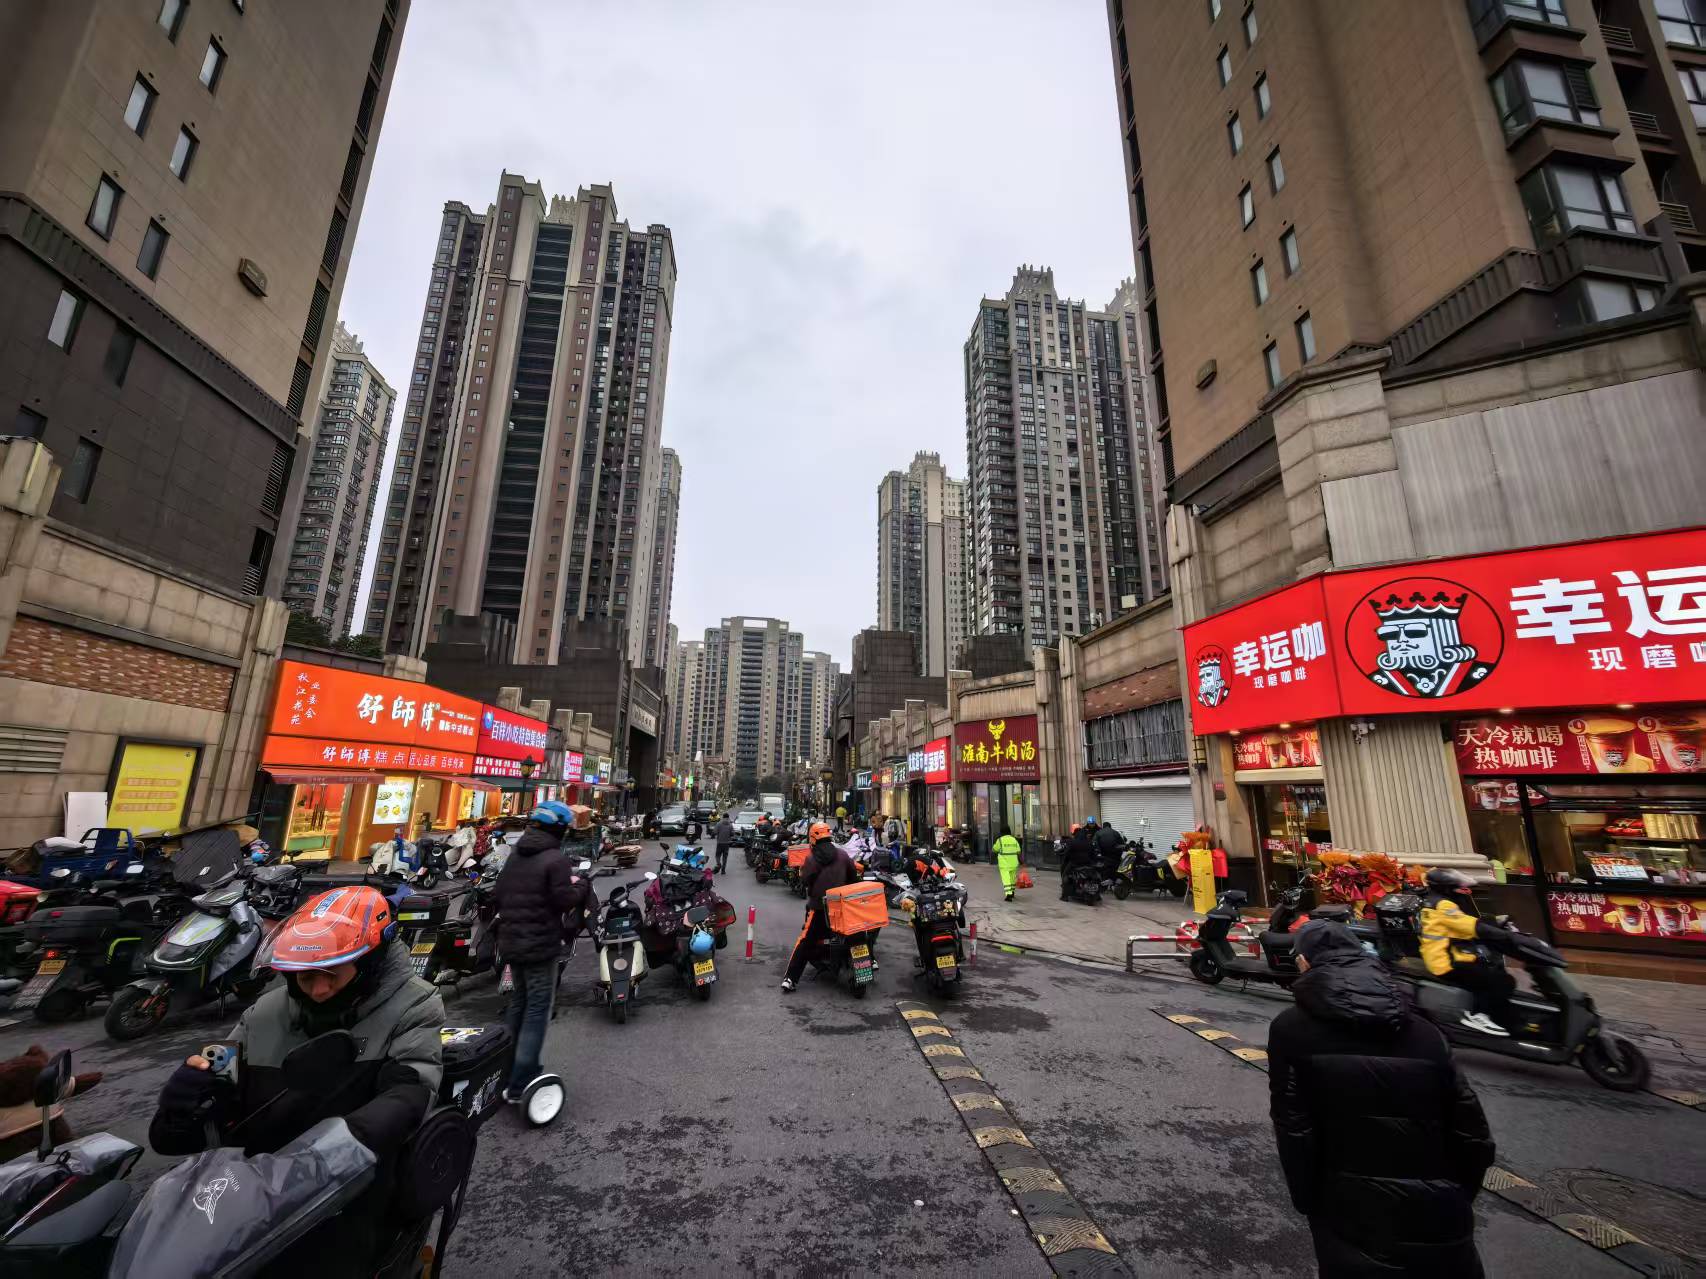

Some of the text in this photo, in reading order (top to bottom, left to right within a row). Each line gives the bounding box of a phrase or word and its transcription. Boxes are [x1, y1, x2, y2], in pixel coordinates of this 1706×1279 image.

[1232, 620, 1327, 677] 幸运咖
[1253, 666, 1307, 689] 现磨咖啡
[304, 681, 321, 719] 业委会
[1457, 725, 1564, 747] 天冷就喝
[1473, 745, 1558, 769] 热咖啡
[1548, 890, 1606, 906] 天冷就喝
[1557, 901, 1602, 917] 热咖啡
